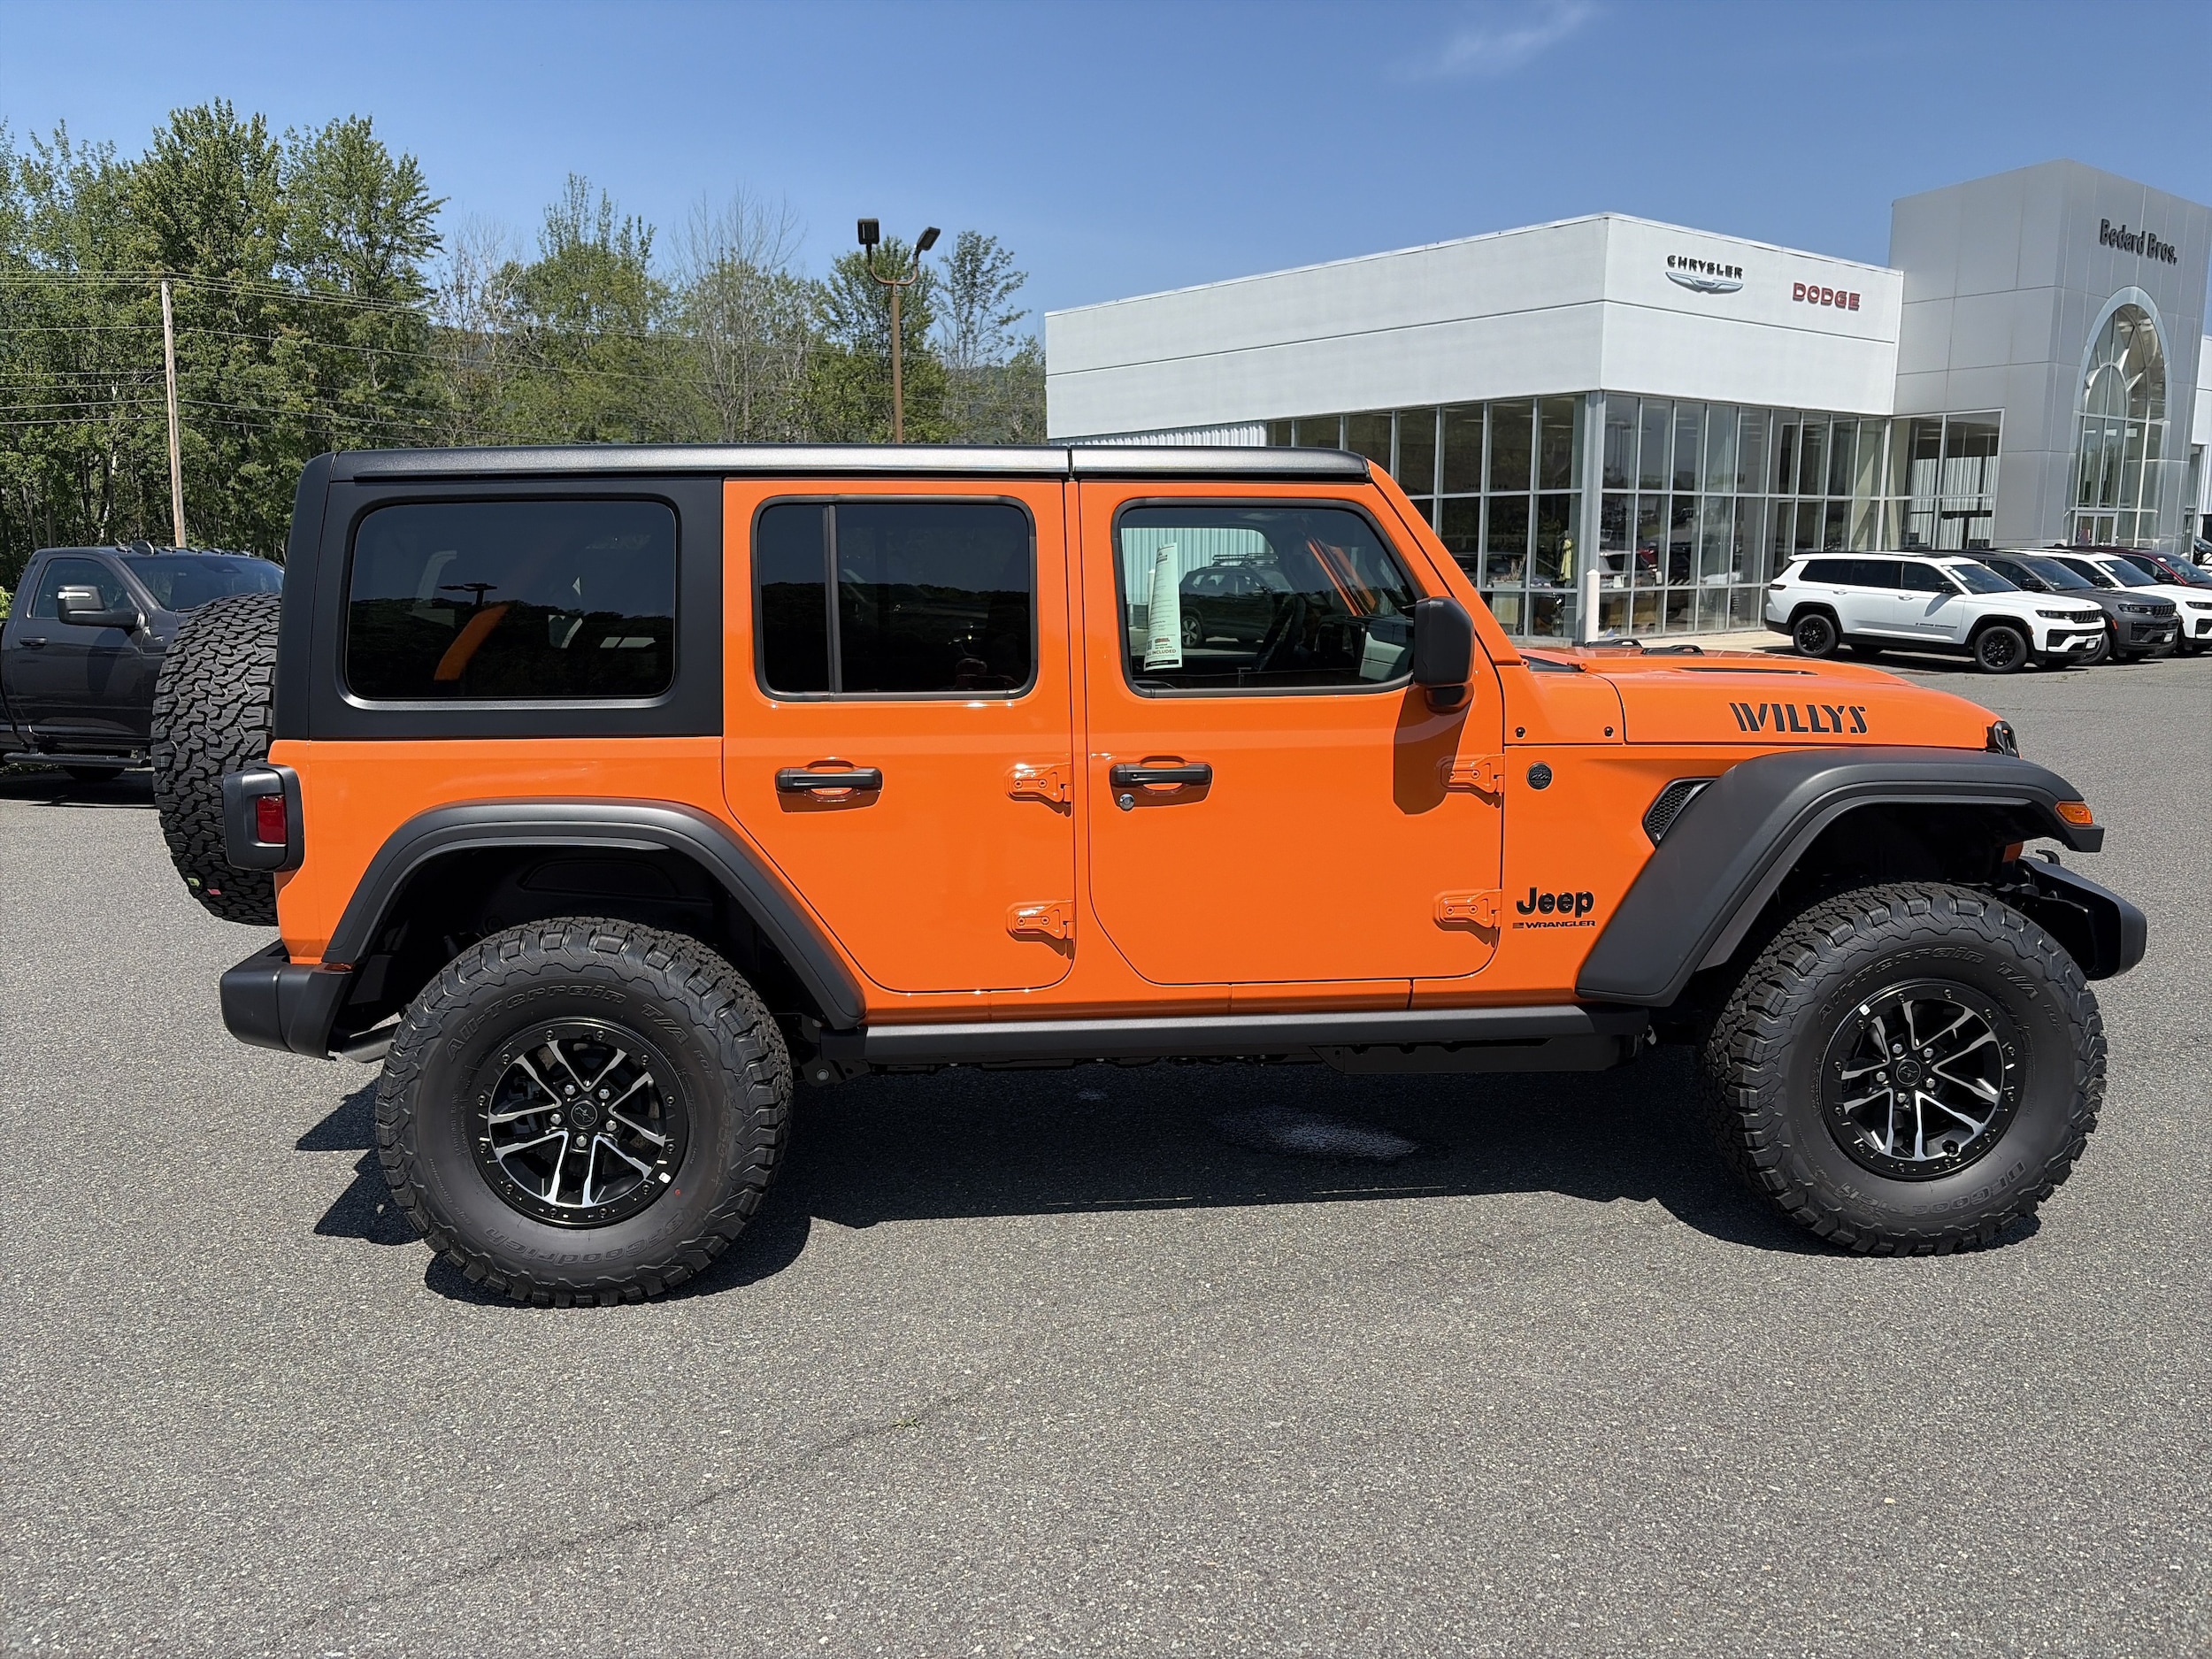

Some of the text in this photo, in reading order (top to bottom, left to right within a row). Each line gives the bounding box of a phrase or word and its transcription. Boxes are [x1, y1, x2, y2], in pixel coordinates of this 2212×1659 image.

[2100, 219, 2177, 265] Bedard Bros.
[1667, 255, 1743, 279] CHRYSLER
[1793, 282, 1861, 311] DODGE
[1729, 703, 1867, 733] WILLYS
[1516, 887, 1594, 918] Jeep
[1525, 920, 1595, 929] WRANGLER
[446, 985, 627, 1063] All-Terrain
[641, 1002, 688, 1045] T/A
[485, 1210, 687, 1266] BFGoodrich
